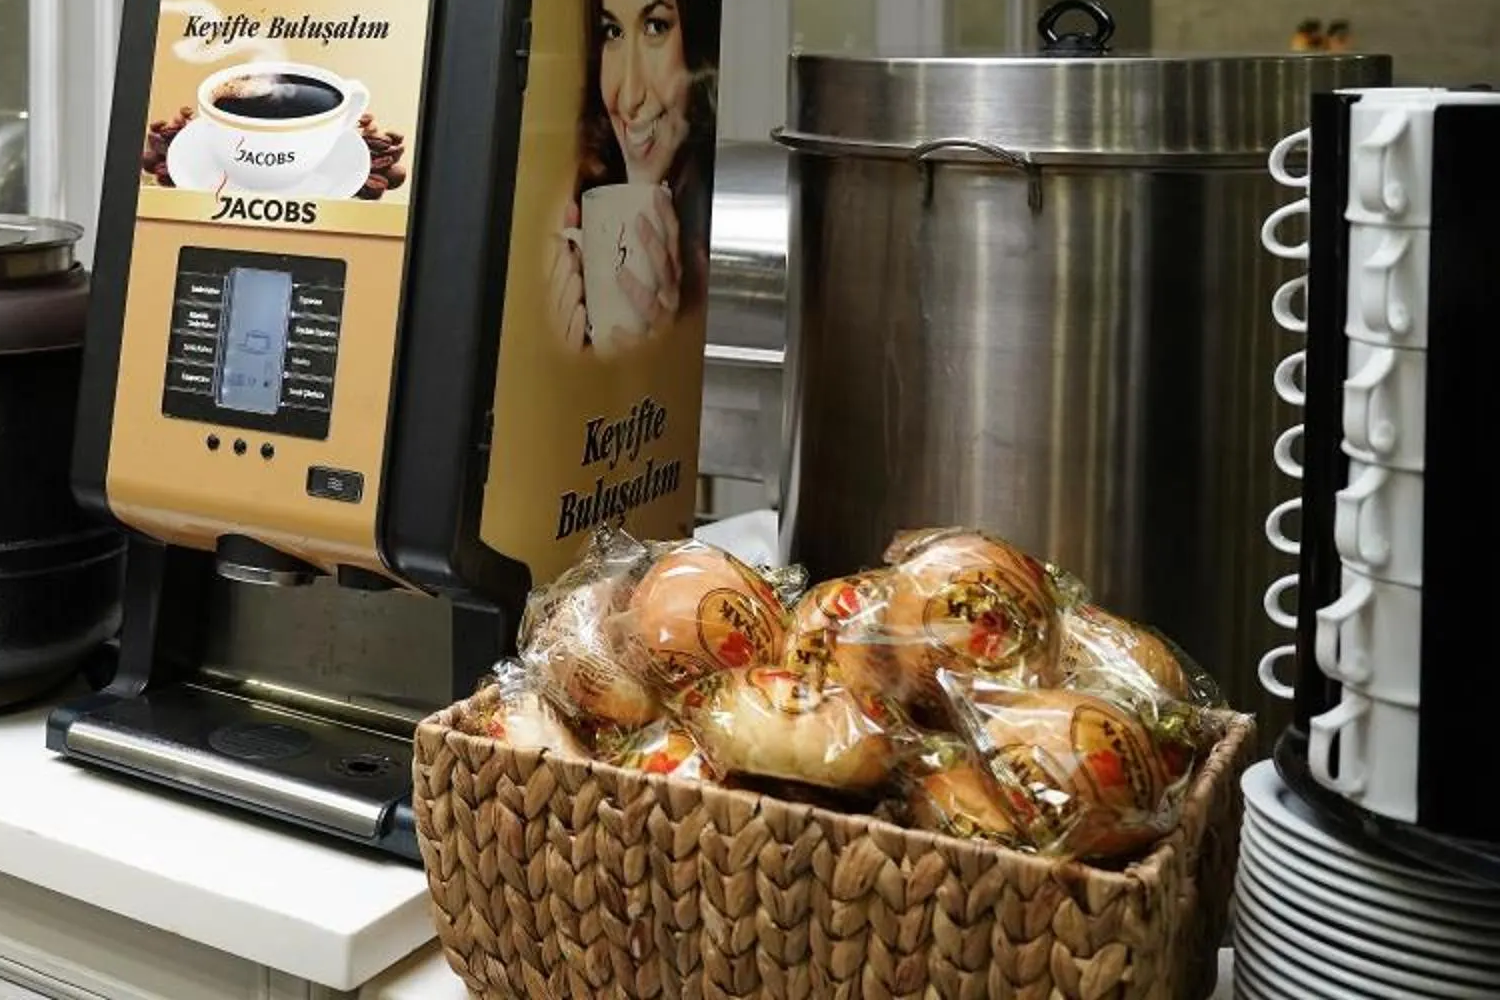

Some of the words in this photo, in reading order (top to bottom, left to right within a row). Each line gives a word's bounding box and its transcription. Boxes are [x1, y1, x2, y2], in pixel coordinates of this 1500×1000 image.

[183, 14, 261, 45] Keyifte
[266, 14, 390, 46] Buluşalım
[234, 149, 296, 167] JACOBS
[211, 196, 317, 224] JACOBS
[581, 396, 667, 470] Keyifte
[555, 458, 682, 541] Buluşalım
